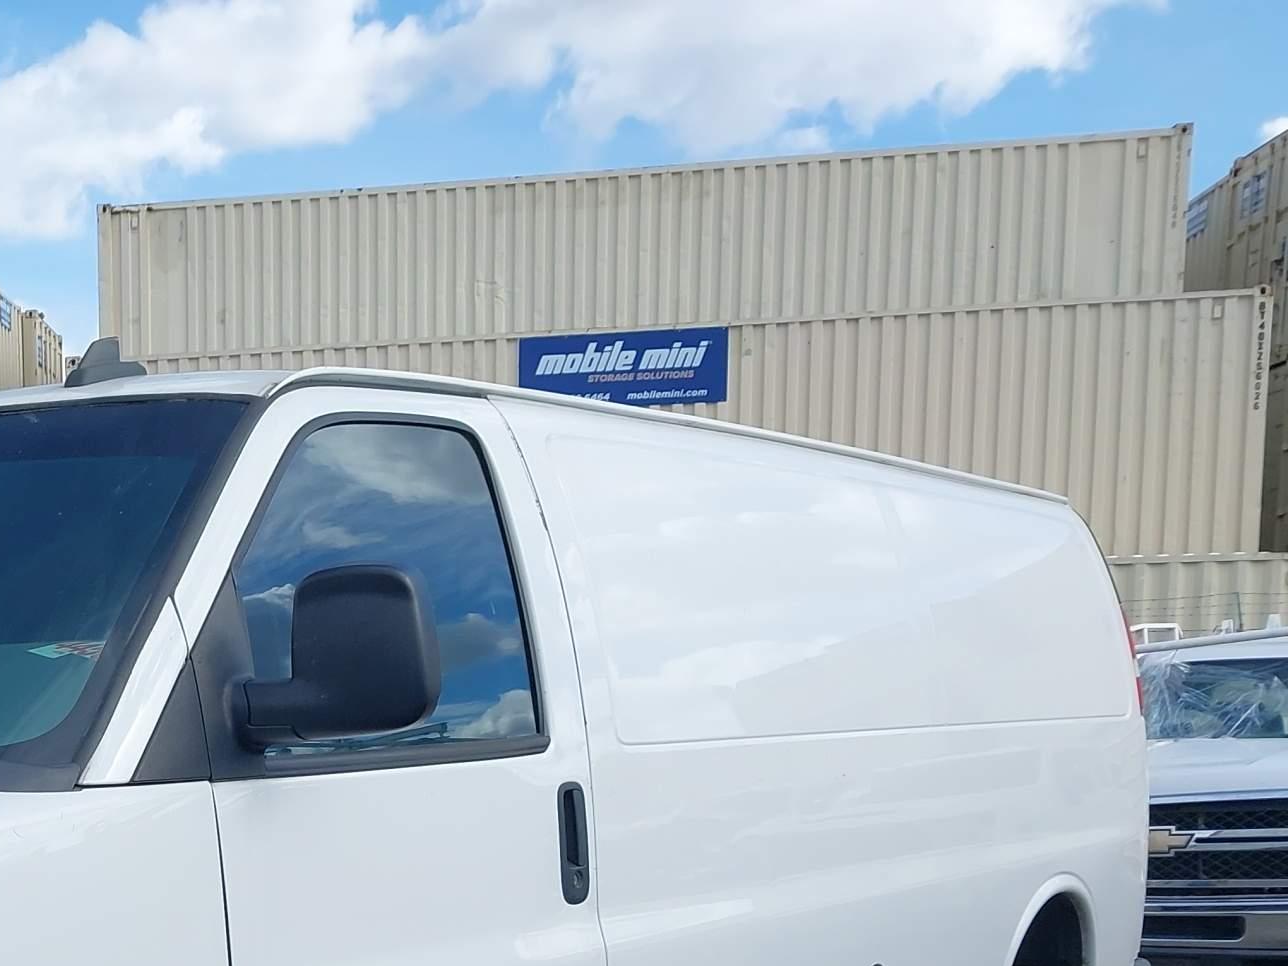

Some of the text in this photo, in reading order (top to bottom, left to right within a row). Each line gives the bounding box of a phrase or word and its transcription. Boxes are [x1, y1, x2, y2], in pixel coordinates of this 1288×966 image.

[536, 340, 709, 376] mobile mini
[587, 369, 695, 383] STORAGE SOLUTIONS
[627, 388, 708, 400] mobilemini.com
